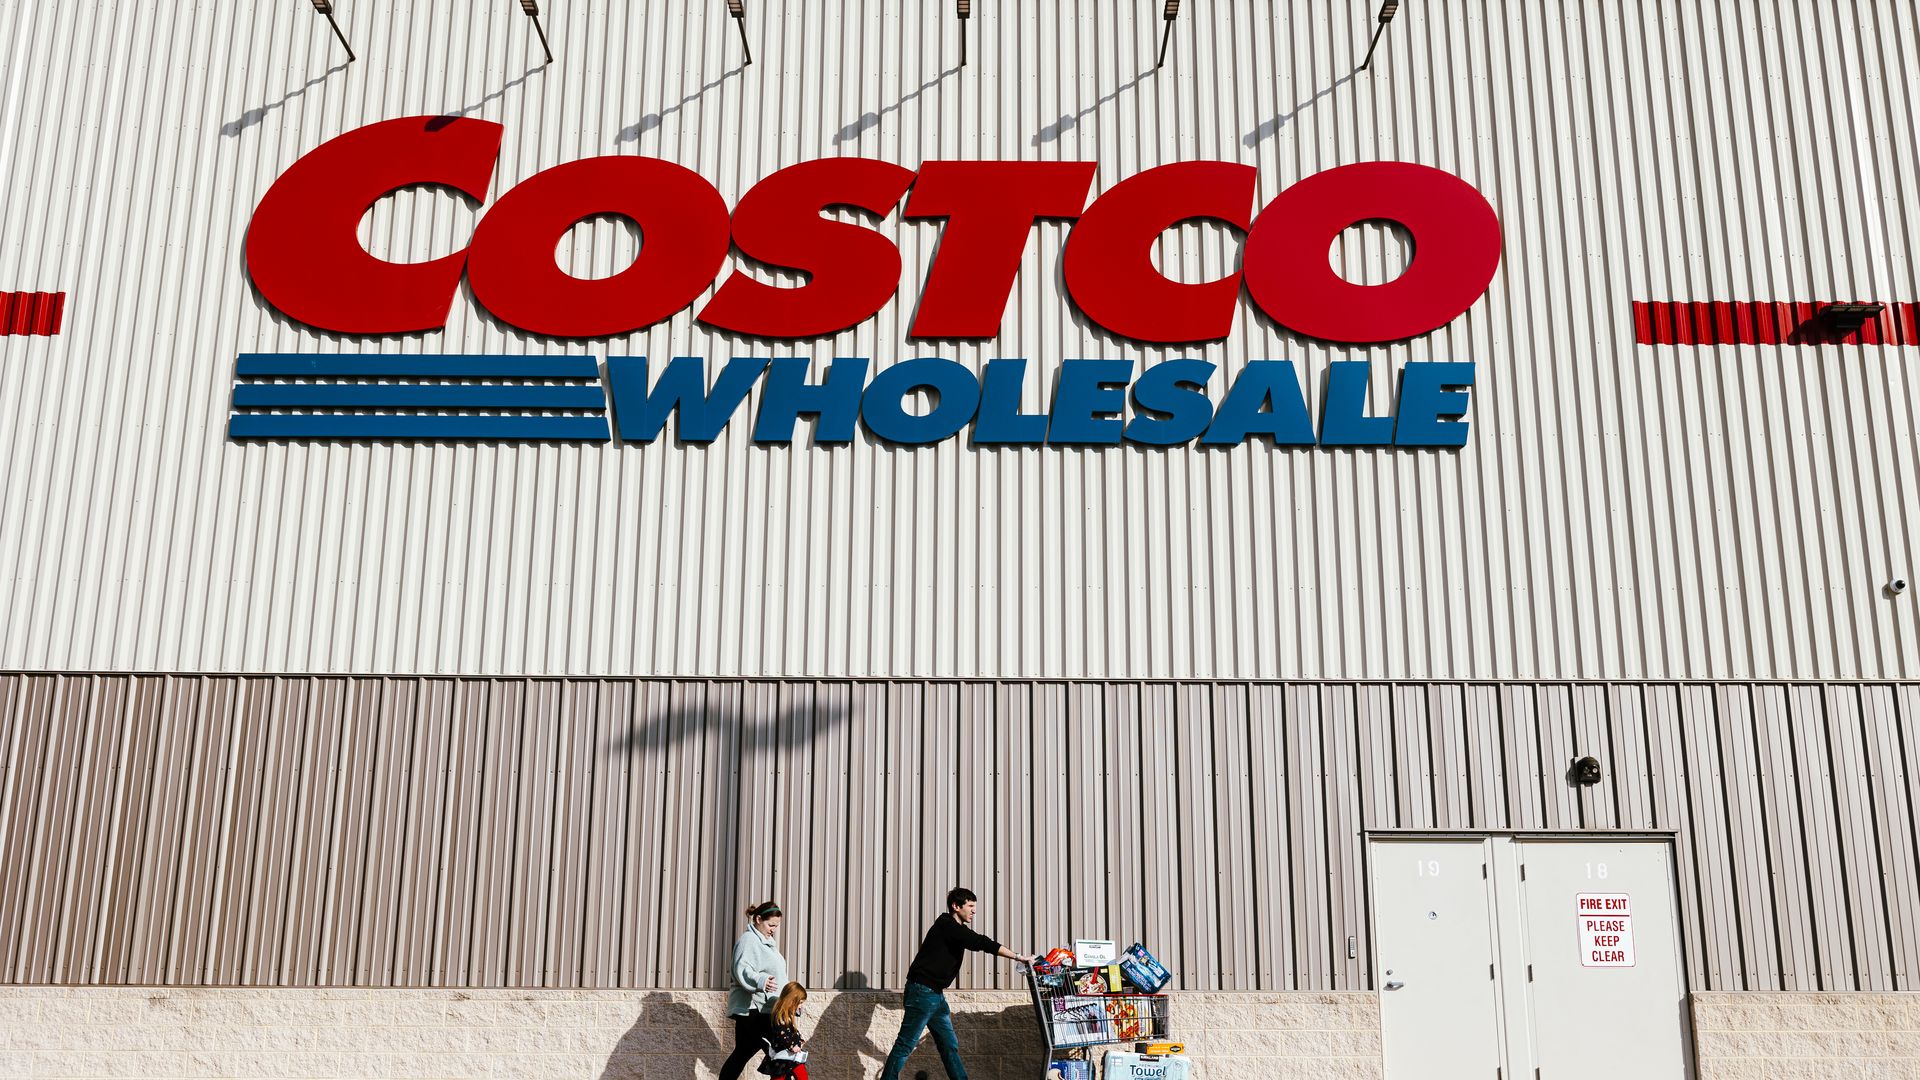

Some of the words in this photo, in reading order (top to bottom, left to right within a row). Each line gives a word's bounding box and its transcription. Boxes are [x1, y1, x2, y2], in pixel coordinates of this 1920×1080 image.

[246, 115, 1502, 343] COSTCO
[606, 355, 1476, 448] WHOLESALE
[1417, 859, 1440, 877] 19
[1585, 862, 1608, 880] 18
[1580, 898, 1603, 910] FIRE
[1605, 898, 1627, 910] EXIT
[1586, 920, 1625, 932] PLEASE
[1594, 935, 1620, 947] KEEP
[1591, 950, 1625, 962] CLEAR
[1130, 1064, 1166, 1077] Towel
